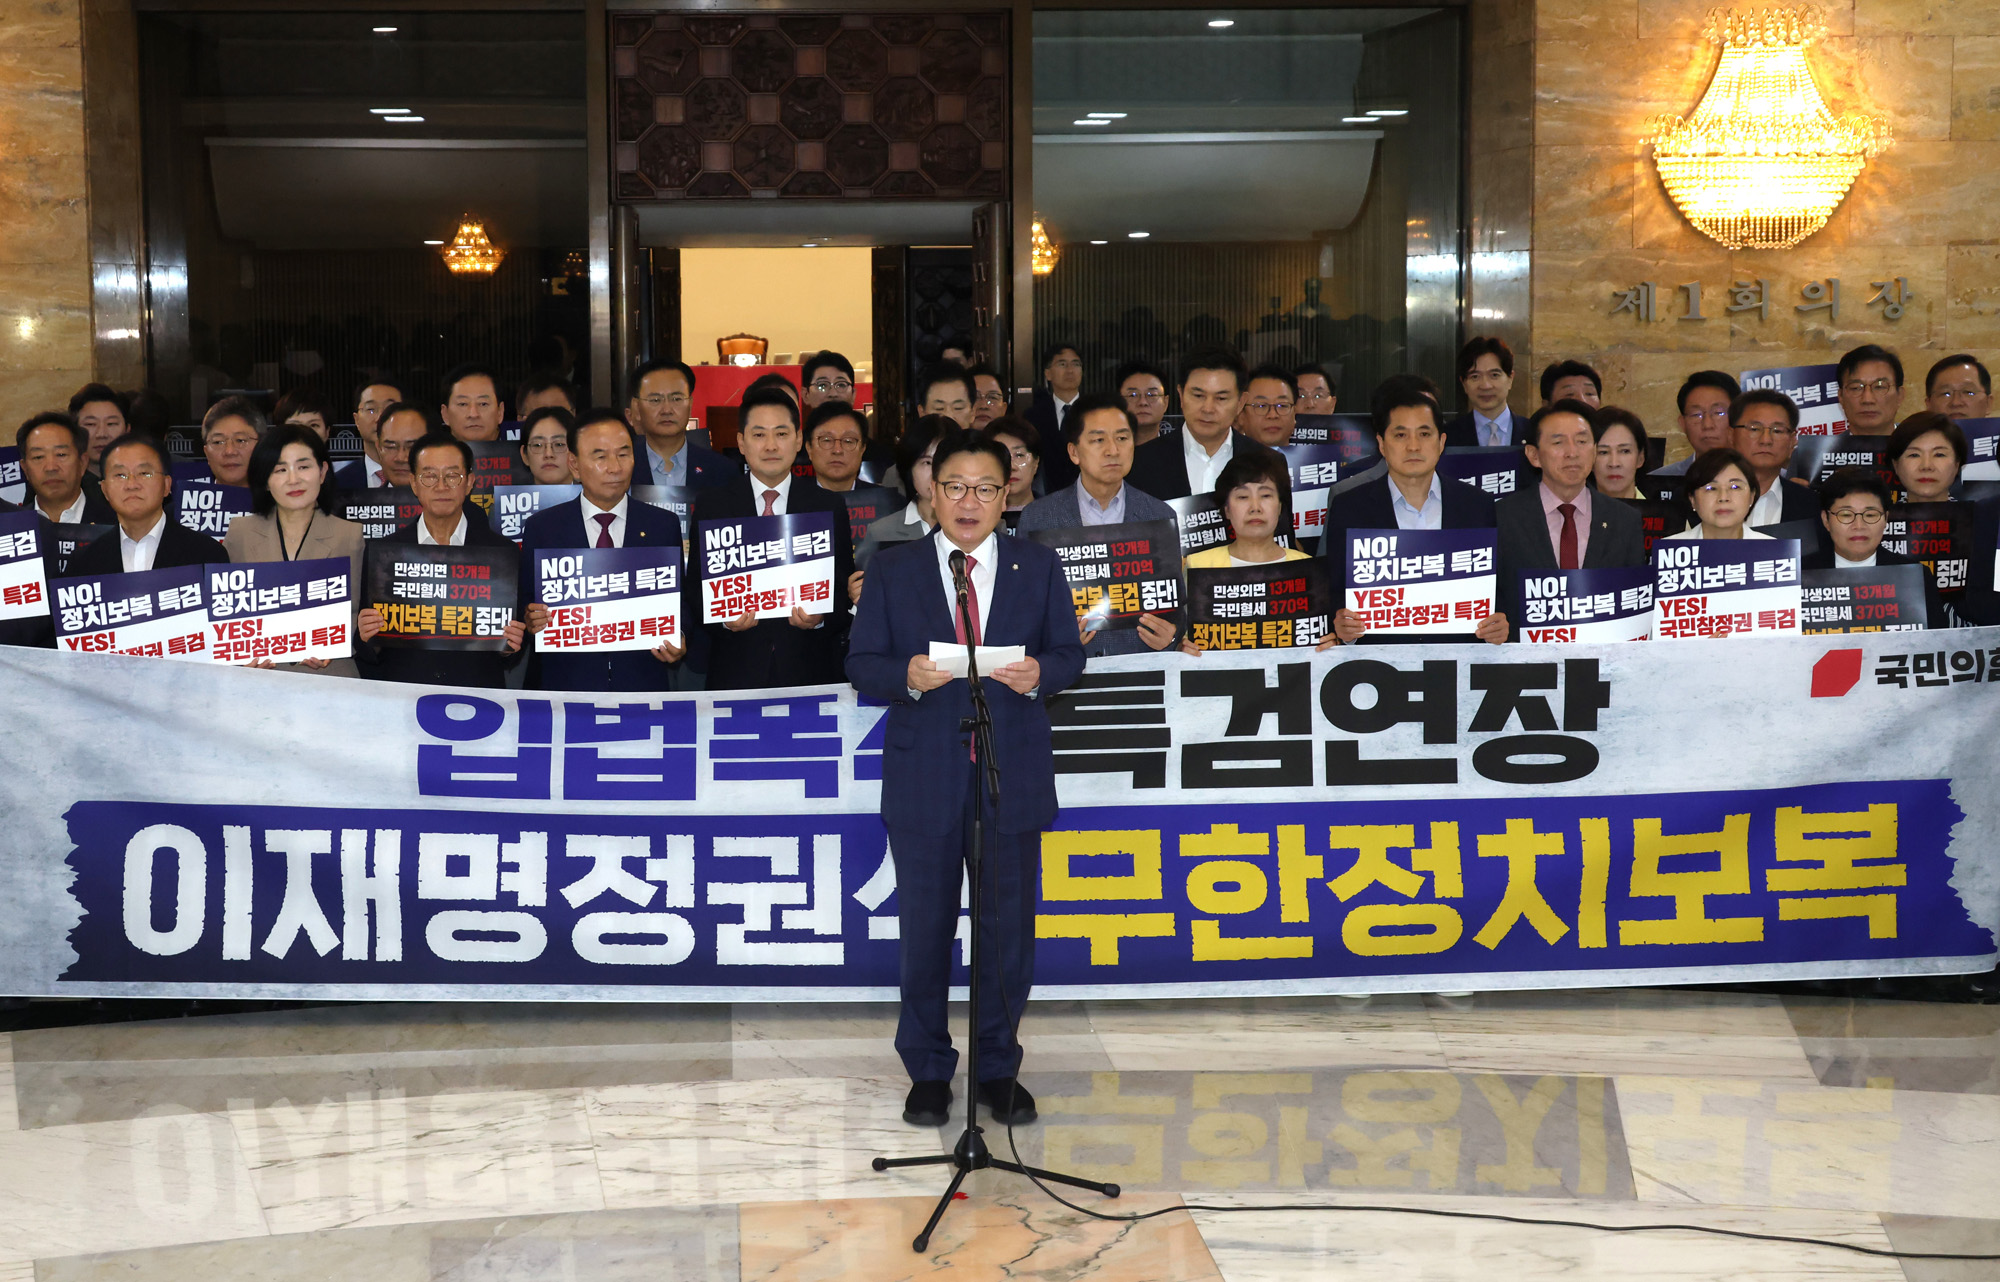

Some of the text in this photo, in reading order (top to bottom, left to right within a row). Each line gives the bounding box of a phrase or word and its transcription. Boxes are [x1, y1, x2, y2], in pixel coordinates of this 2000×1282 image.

[1608, 276, 1914, 323] 제1회의장
[1746, 373, 1781, 391] NO!
[1779, 381, 1840, 405] 보복 특
[1832, 420, 1849, 434] 특
[475, 457, 511, 470] 13개월
[1823, 452, 1873, 465] 민생외면
[0, 461, 21, 484] 검
[475, 474, 512, 488] 370억
[1300, 461, 1337, 485] 특검
[1481, 469, 1516, 494] 특검
[181, 490, 223, 510] NO!
[500, 491, 540, 514] NO!
[346, 505, 423, 520] 민생외면 13개
[848, 505, 876, 520] 개월
[363, 523, 396, 538] 민혈세
[705, 524, 742, 550] NO!
[1883, 520, 1949, 535] 외면 13개월
[706, 529, 831, 574] 정치보복 특검
[1055, 540, 1150, 561] 민생외면 13개월
[1353, 536, 1397, 559] NO!
[1658, 545, 1699, 569] NO!
[1911, 539, 1951, 555] 370억
[394, 562, 490, 580] 민생외면 13개월
[541, 555, 583, 579] NO!
[1113, 559, 1154, 578] 370억
[1353, 547, 1493, 584] 정치보복 특검
[1658, 558, 1797, 593] 정치보복 특검
[1936, 559, 1968, 589] 중단!
[211, 569, 255, 593] NO!
[393, 582, 491, 600] 국민혈세 370억
[541, 565, 677, 603] 정치보복 특검
[709, 574, 752, 599] YES!
[1213, 577, 1306, 598] 민생외면 13개월
[1525, 576, 1567, 599] NO!
[1801, 584, 1896, 602] 민생외면 13개월
[3, 581, 42, 606] 특검
[57, 582, 102, 608] NO!
[212, 574, 347, 617] 정치보복 특검
[710, 579, 830, 618] 국민참정권 특검
[1071, 579, 1178, 616] 보복 특검 중단!
[1353, 587, 1404, 609] YES!
[1525, 583, 1653, 623] 정치보복 특검
[60, 582, 202, 631] 정치보복 특검
[546, 606, 591, 627] YES!
[1212, 597, 1309, 618] 국민혈세 370억
[1355, 598, 1490, 630] 국민참정권 특검
[1659, 596, 1707, 618] YES!
[1801, 603, 1899, 622] 국민혈세 370억
[212, 618, 263, 641] YES!
[440, 605, 473, 635] 특검
[543, 615, 675, 648] 국민참정권 특검
[1660, 612, 1752, 638] 국민참정권
[1758, 608, 1796, 630] 특검
[65, 631, 116, 652] YES!
[168, 631, 205, 655] 특검
[213, 624, 346, 661] 국민참정권 특검
[1193, 621, 1257, 651] 정치보복
[1261, 619, 1293, 648] 특검
[1045, 658, 1609, 790] 특검연장
[1034, 803, 1908, 966] 무한정치보복
